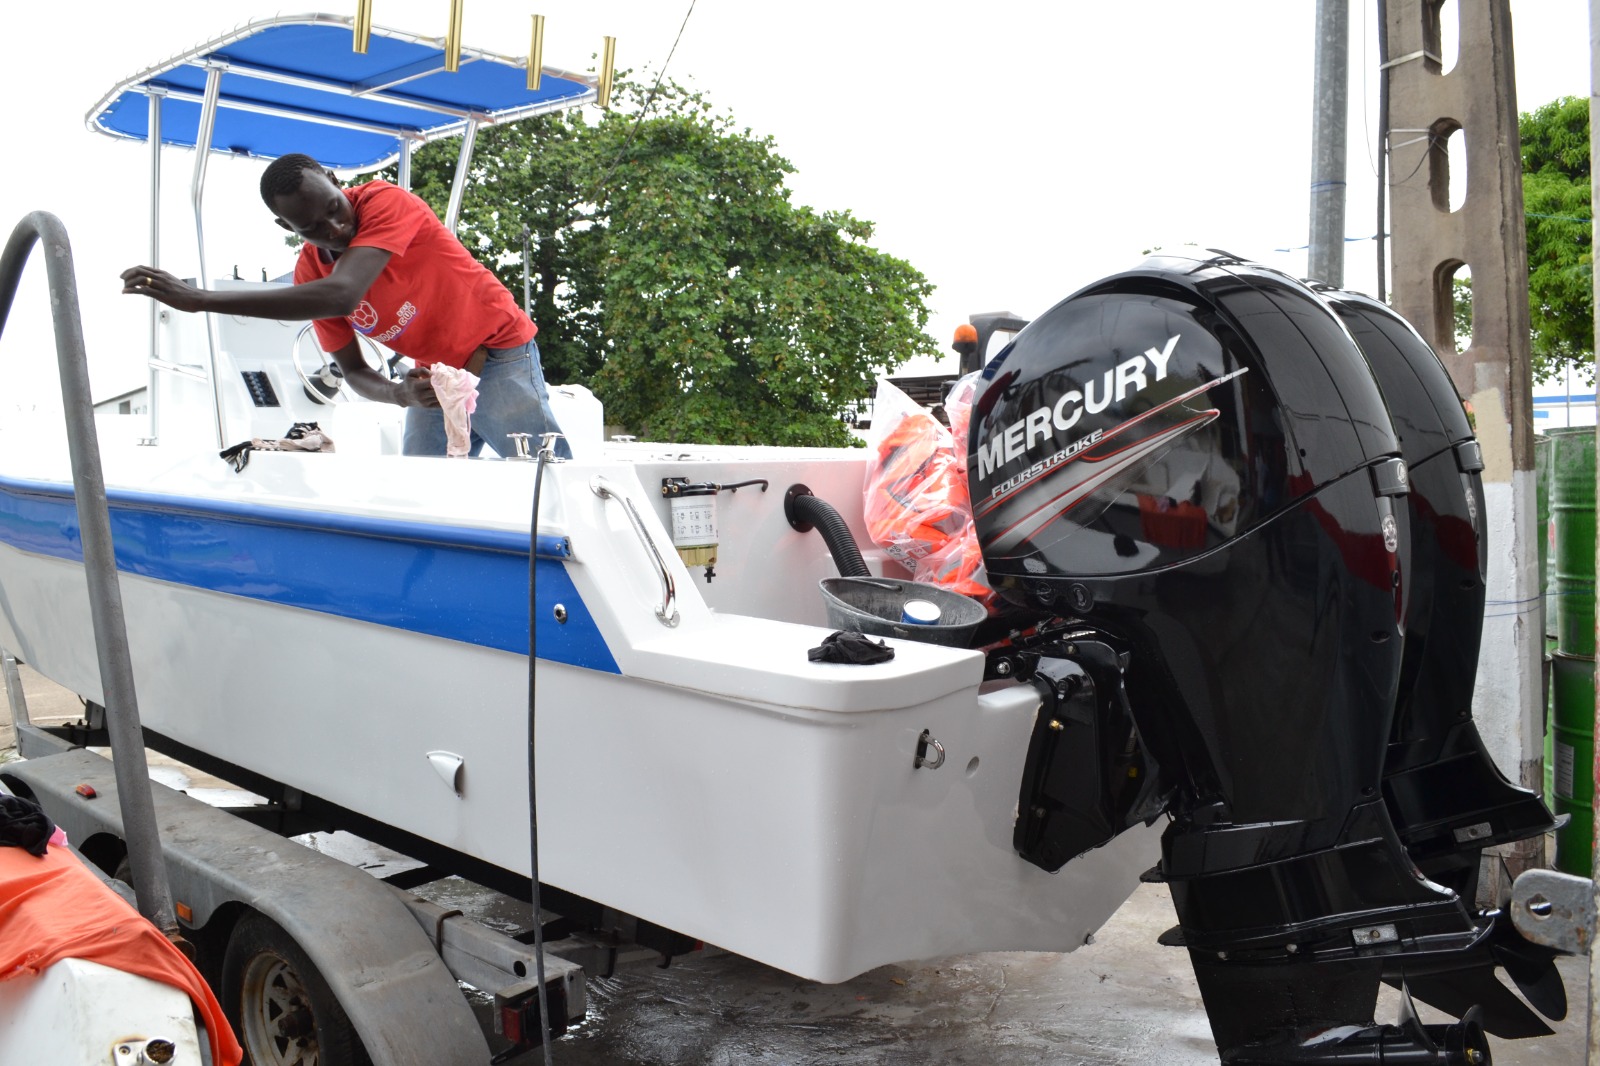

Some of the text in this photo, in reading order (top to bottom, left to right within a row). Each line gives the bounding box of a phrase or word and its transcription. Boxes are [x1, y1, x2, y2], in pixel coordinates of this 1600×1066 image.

[398, 305, 416, 326] CUP
[977, 334, 1181, 481] MERCURY
[991, 428, 1103, 499] FOURSTROKE
